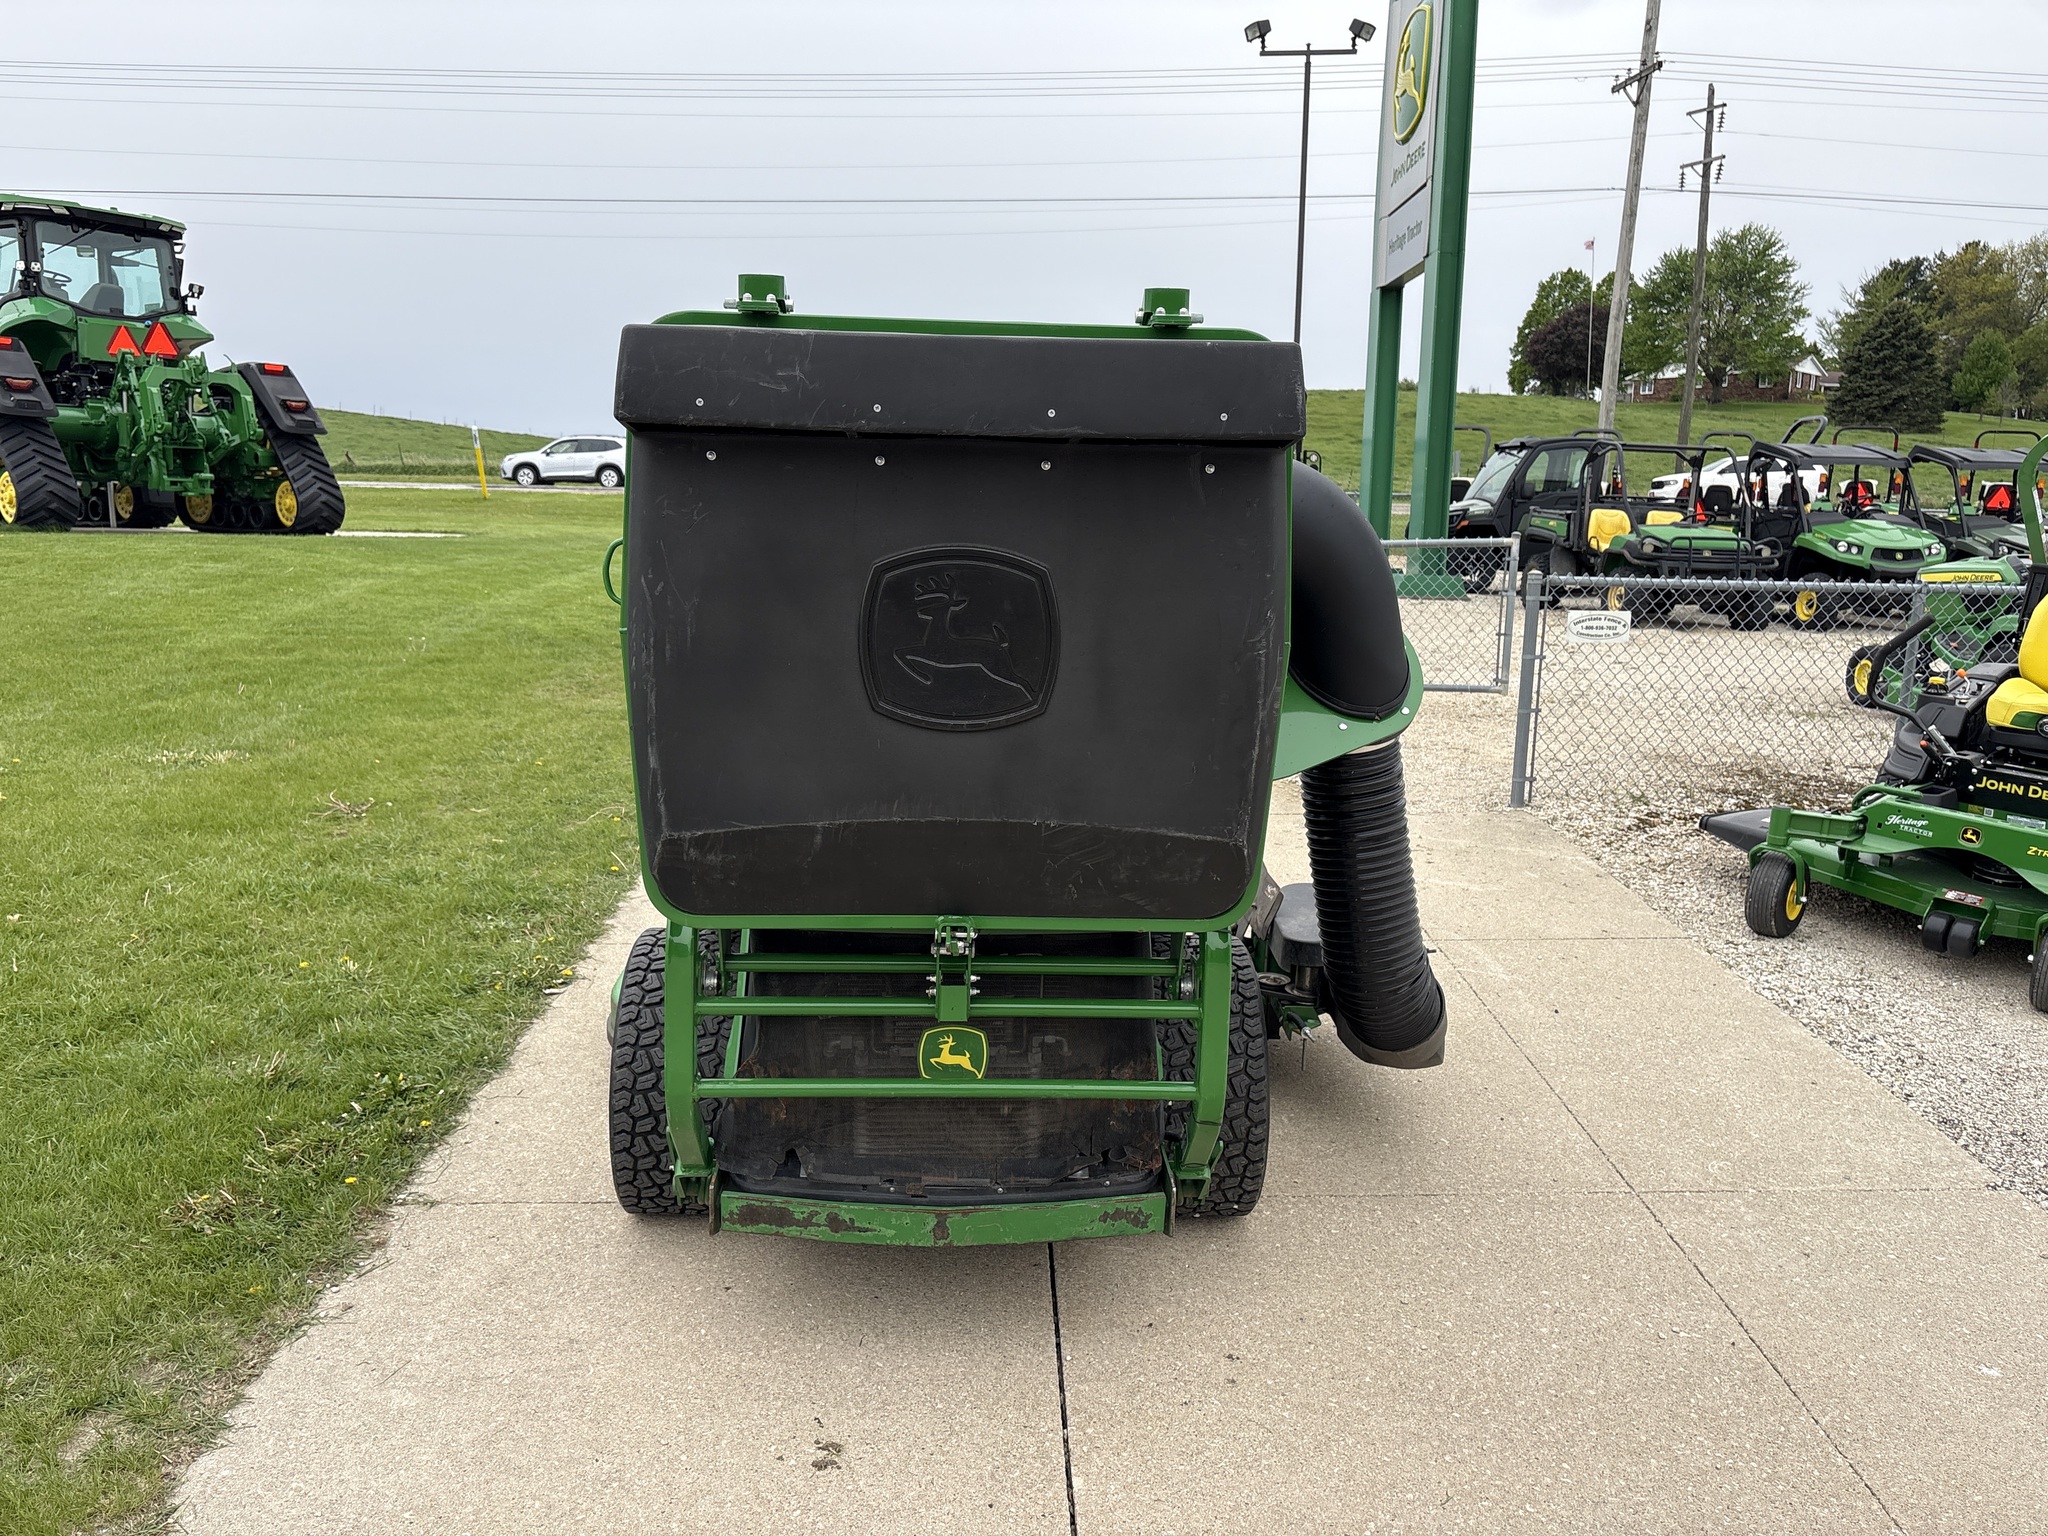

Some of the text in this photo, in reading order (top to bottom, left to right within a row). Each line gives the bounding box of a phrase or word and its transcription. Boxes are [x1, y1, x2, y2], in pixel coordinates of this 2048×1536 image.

[1391, 140, 1426, 188] JOHN DEERE
[1388, 220, 1423, 256] Heritage Tractor
[1573, 616, 1602, 627] Interstate
[1604, 616, 1622, 625] Fence
[1576, 630, 1604, 638] Construction
[1975, 776, 2024, 796] JOHN
[1884, 814, 1929, 828] Heritage
[1899, 824, 1933, 838] TRACTOR
